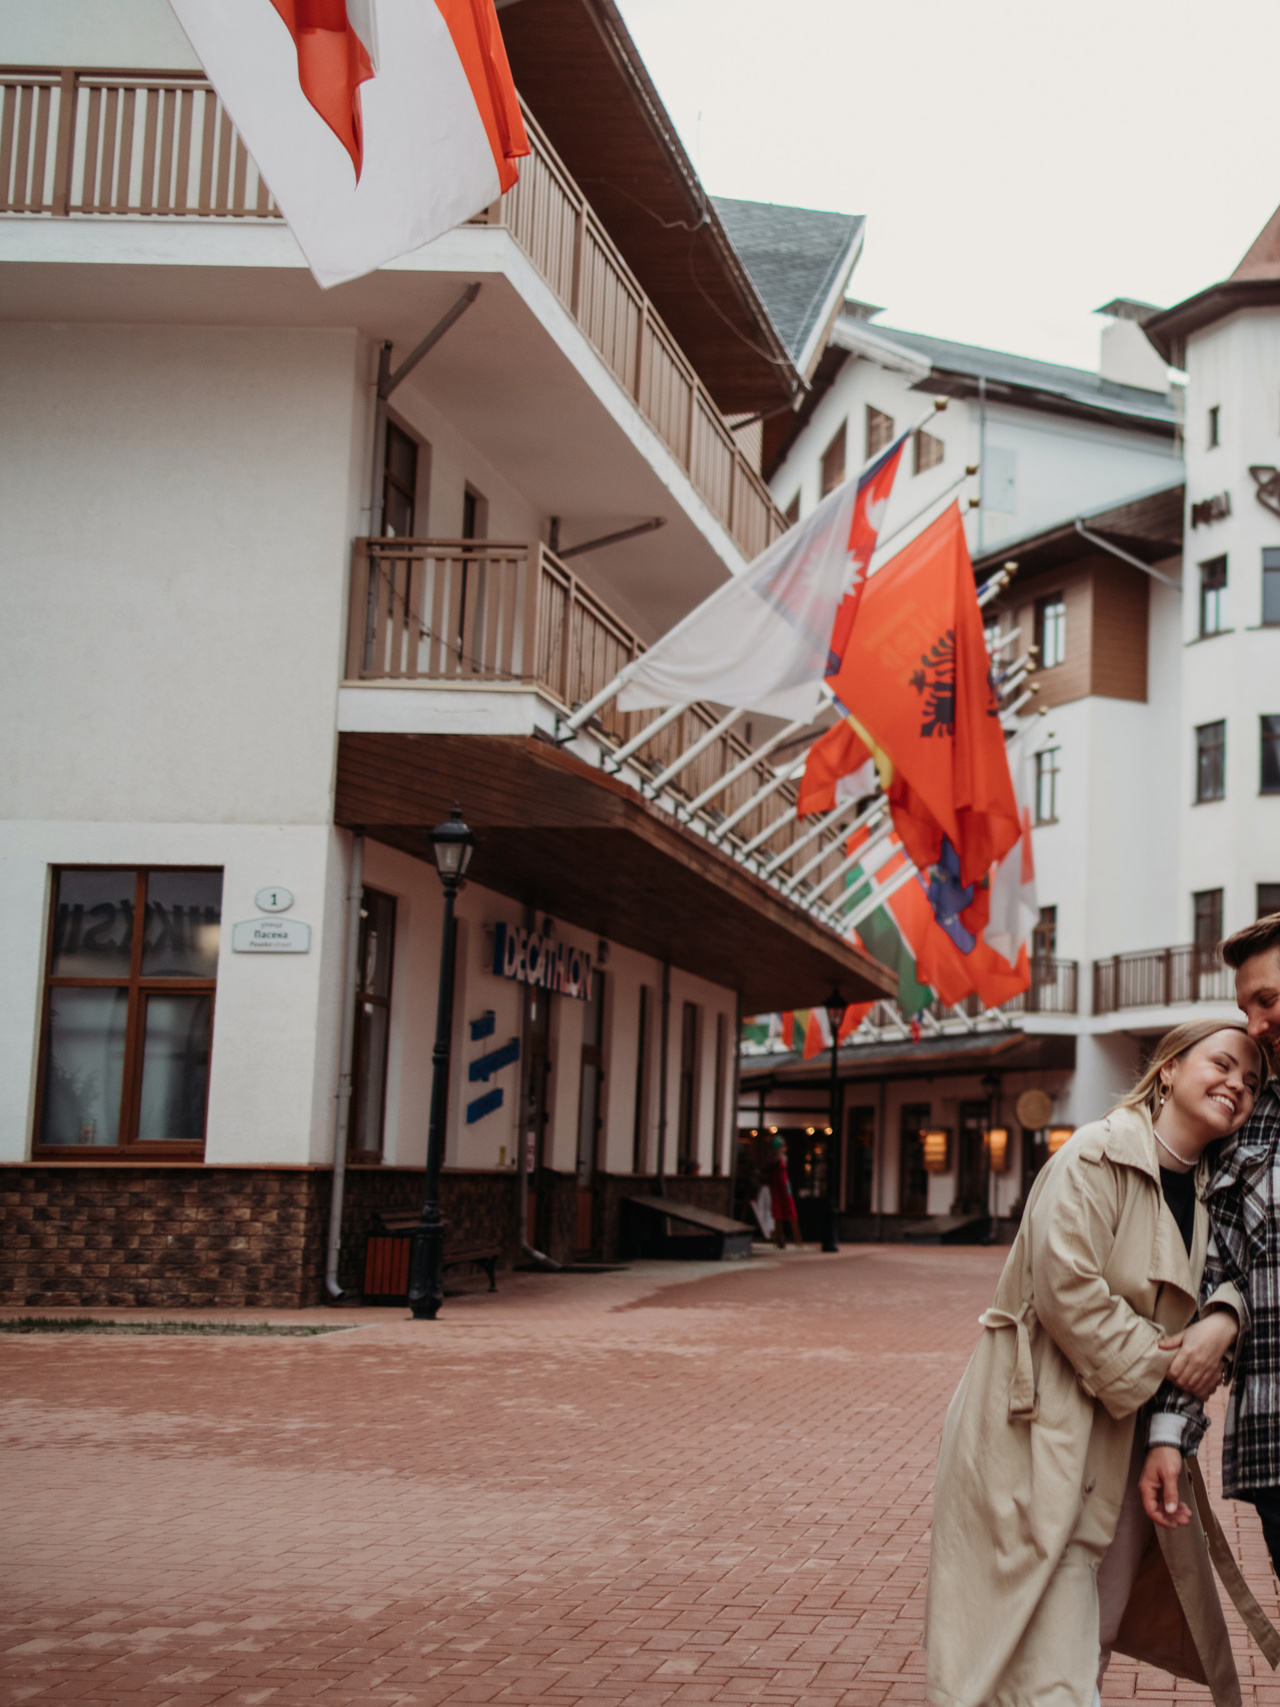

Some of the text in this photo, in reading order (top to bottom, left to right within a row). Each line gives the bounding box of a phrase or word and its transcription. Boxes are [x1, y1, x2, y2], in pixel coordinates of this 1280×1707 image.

[270, 893, 278, 906] 1
[254, 930, 288, 939] Пасека
[504, 923, 592, 1001] DECATHLON
